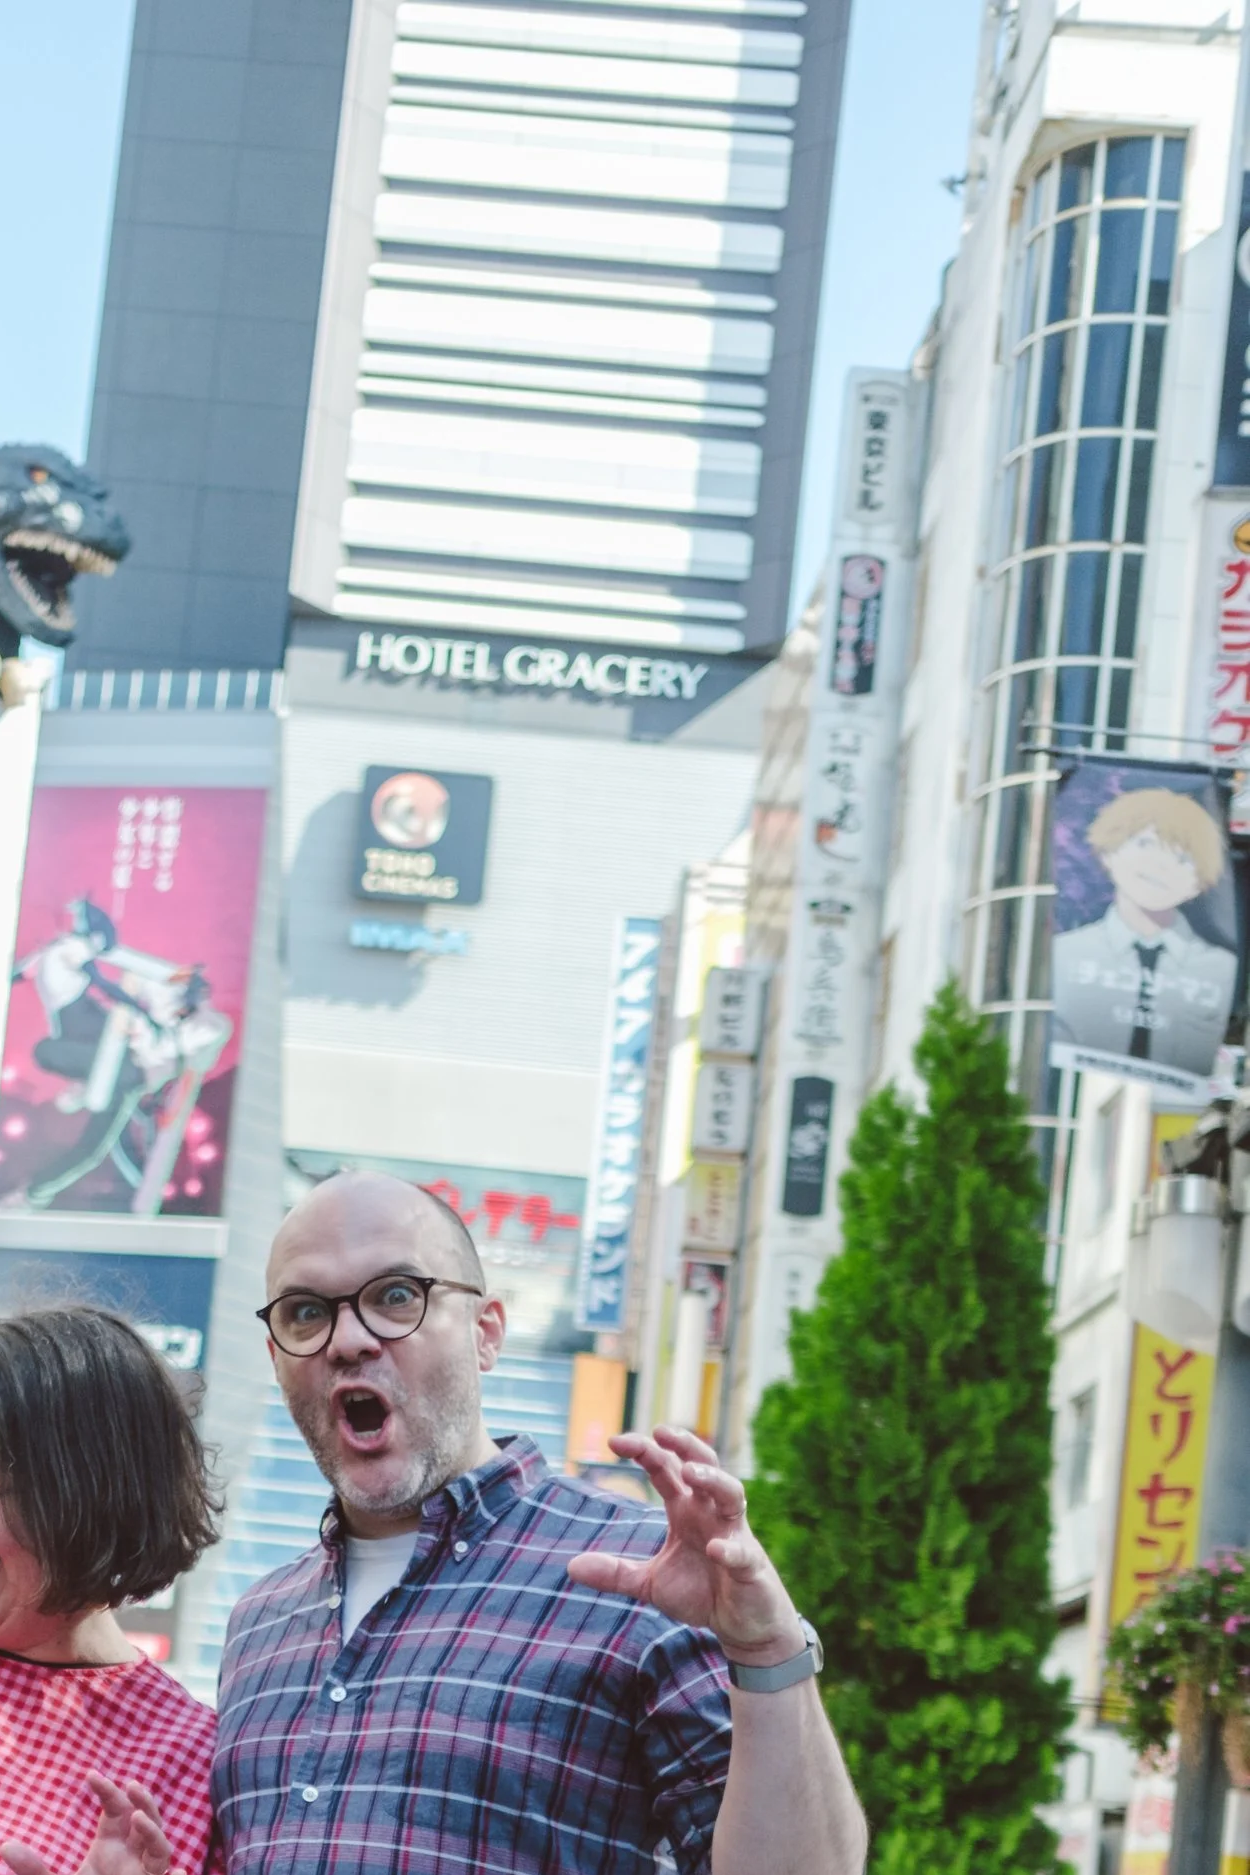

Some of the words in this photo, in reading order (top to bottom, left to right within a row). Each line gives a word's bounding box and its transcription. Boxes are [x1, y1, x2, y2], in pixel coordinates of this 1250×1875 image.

[356, 632, 498, 683] HOTEL
[503, 645, 710, 699] GRACERY
[362, 872, 459, 899] CINEMAS
[364, 847, 436, 876] TOHO
[1134, 1348, 1197, 1606] とりセン
